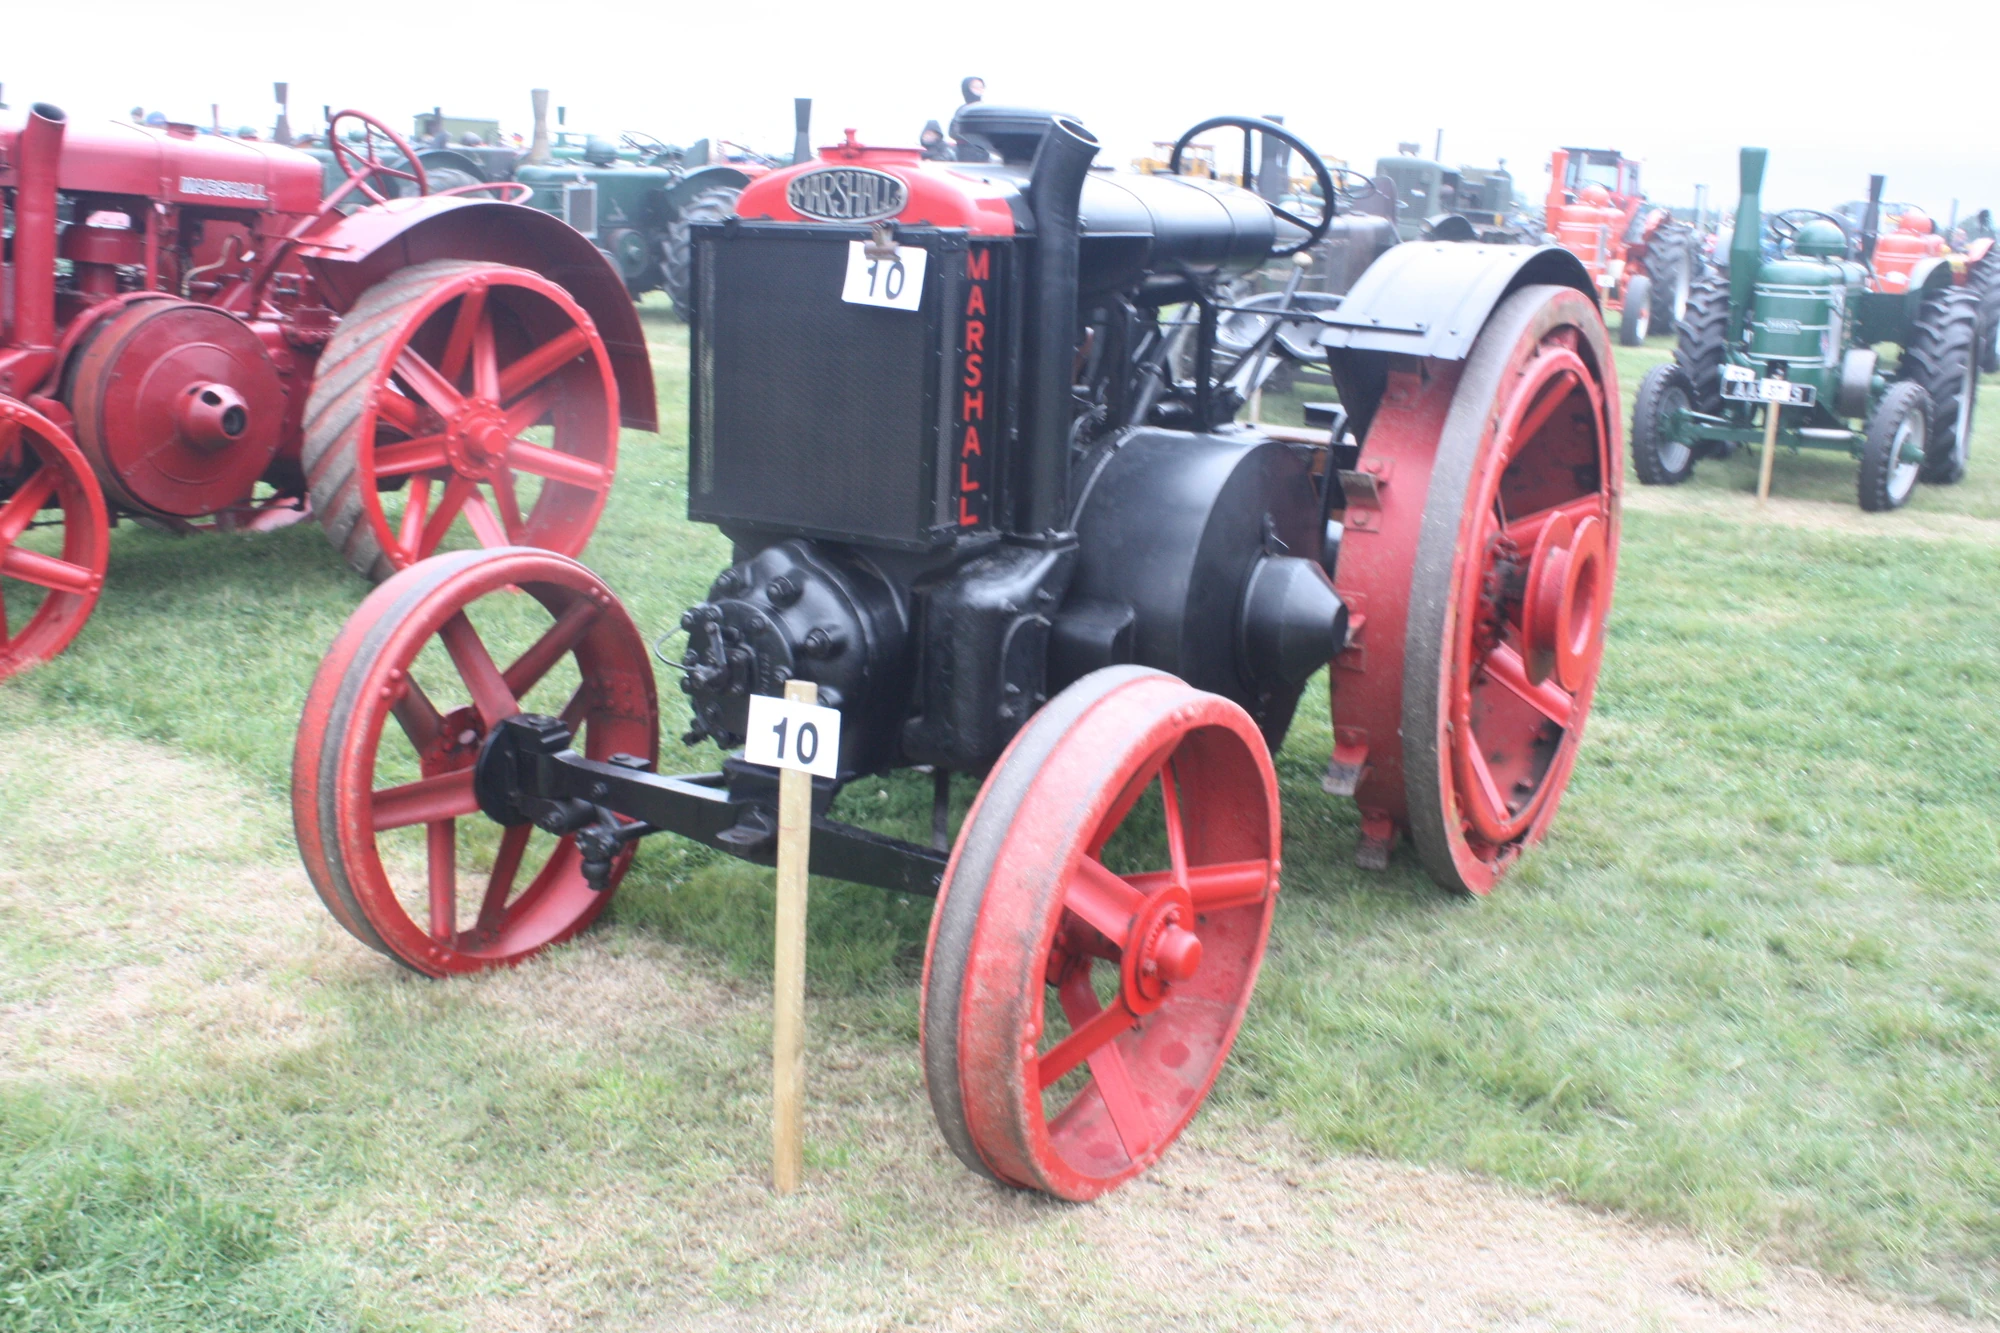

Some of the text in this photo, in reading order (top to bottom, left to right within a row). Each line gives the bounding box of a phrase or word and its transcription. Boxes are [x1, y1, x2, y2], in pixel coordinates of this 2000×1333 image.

[789, 171, 902, 218] MARSHALL
[867, 259, 906, 300] 10
[958, 248, 990, 527] MARSHALL
[772, 716, 819, 765] 10
